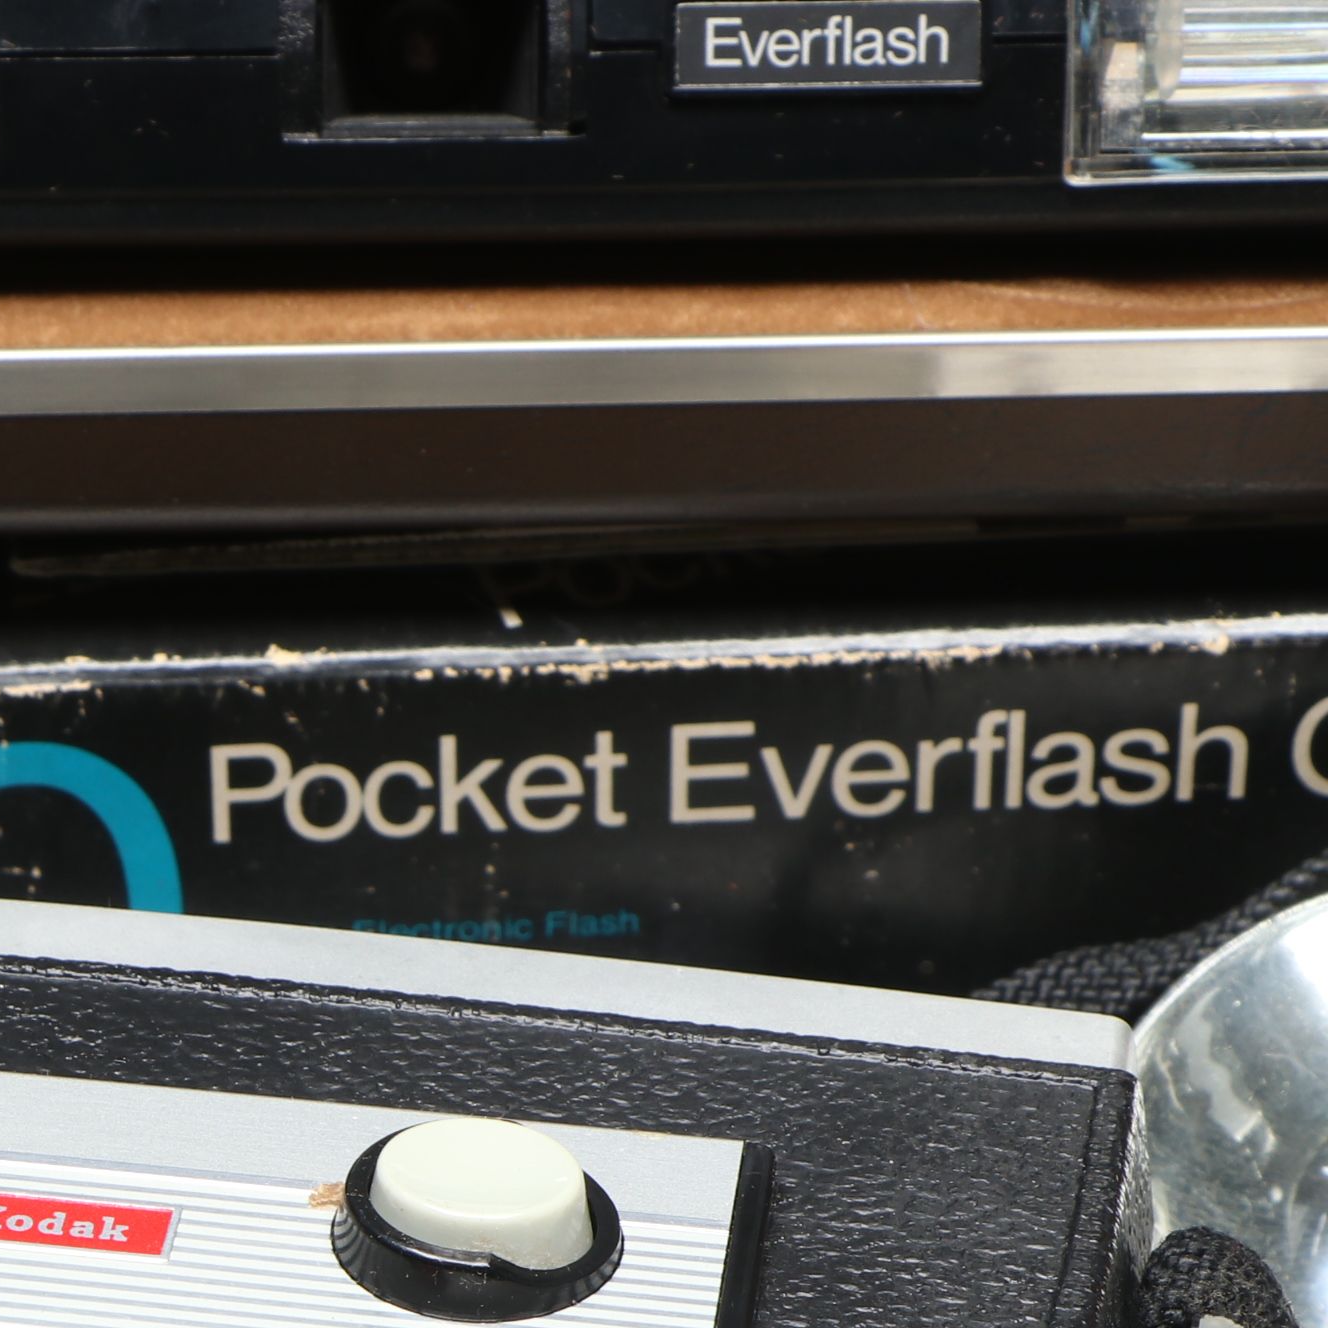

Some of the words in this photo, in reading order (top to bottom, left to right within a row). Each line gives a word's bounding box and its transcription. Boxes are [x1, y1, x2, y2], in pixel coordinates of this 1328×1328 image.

[703, 13, 951, 69] Everflash
[209, 730, 628, 844] Pocket
[670, 702, 1249, 825] Everflash
[544, 908, 641, 939] Flash
